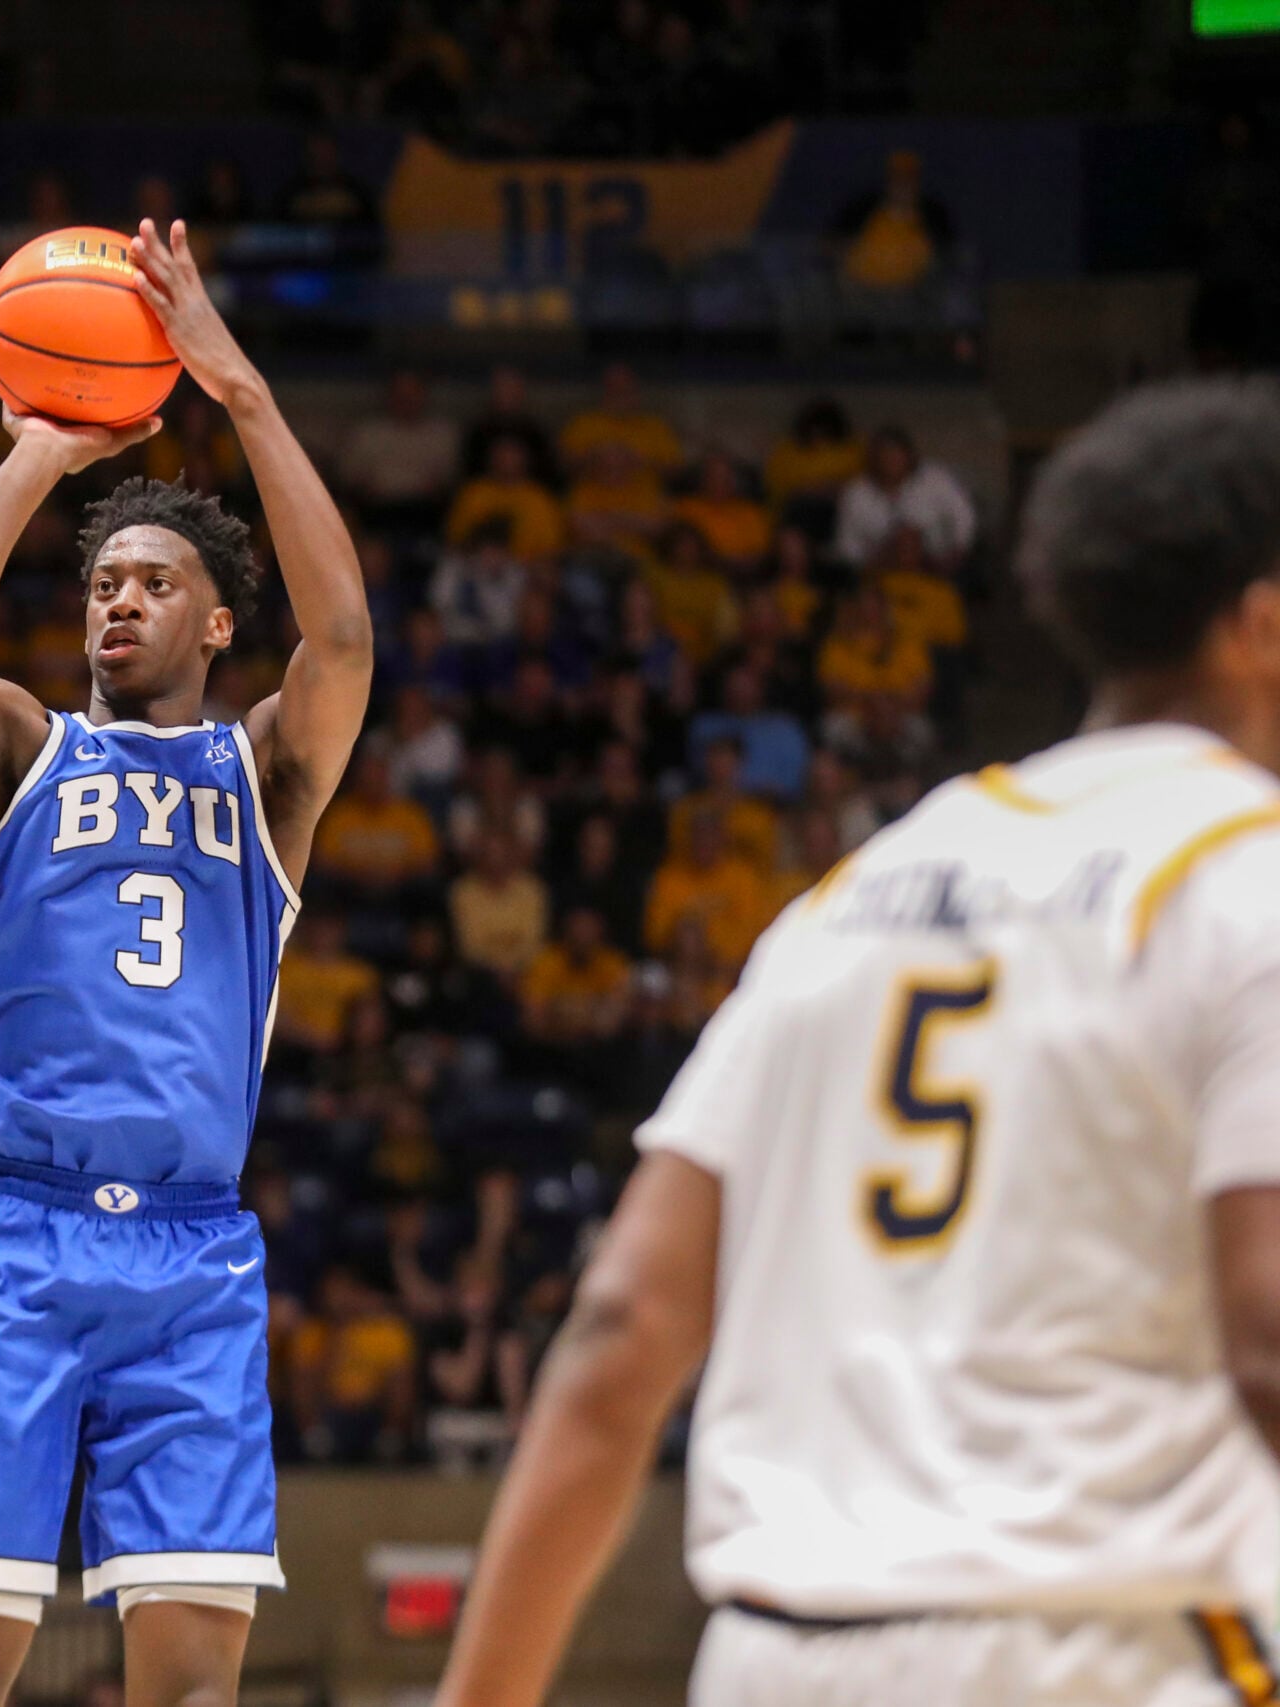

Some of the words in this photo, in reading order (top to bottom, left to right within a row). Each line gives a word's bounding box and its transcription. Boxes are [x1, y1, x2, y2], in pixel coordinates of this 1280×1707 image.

[47, 239, 128, 263] ELIT
[52, 772, 241, 867] BYU
[115, 871, 186, 989] 3
[856, 953, 1001, 1258] 5
[103, 1187, 131, 1209] Y
